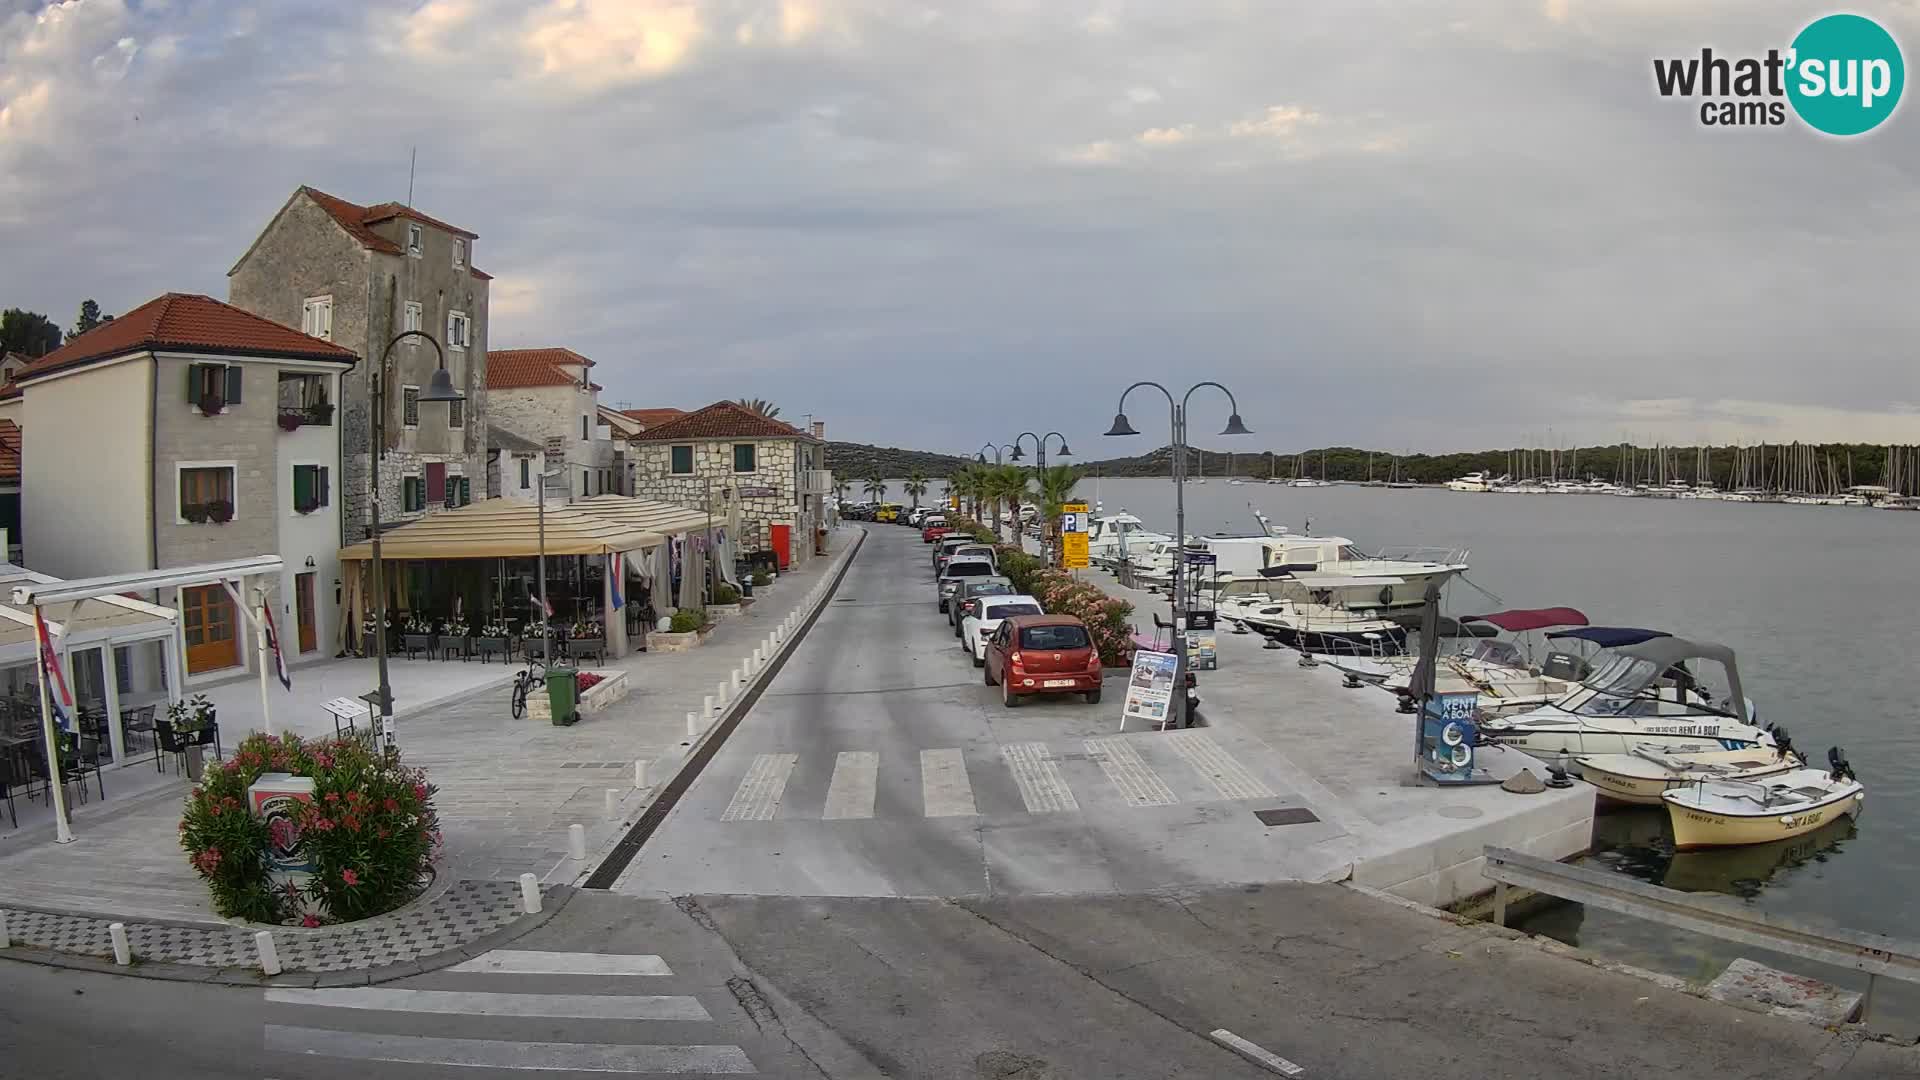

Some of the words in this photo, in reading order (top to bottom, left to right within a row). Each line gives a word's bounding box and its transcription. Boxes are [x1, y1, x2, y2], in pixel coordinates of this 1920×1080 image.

[1064, 514, 1075, 531] P
[1443, 697, 1476, 710] RENT
[1442, 710, 1450, 720] A
[1451, 710, 1475, 720] BOAT
[1678, 725, 1697, 735] RENT
[1703, 725, 1721, 737] BOAT
